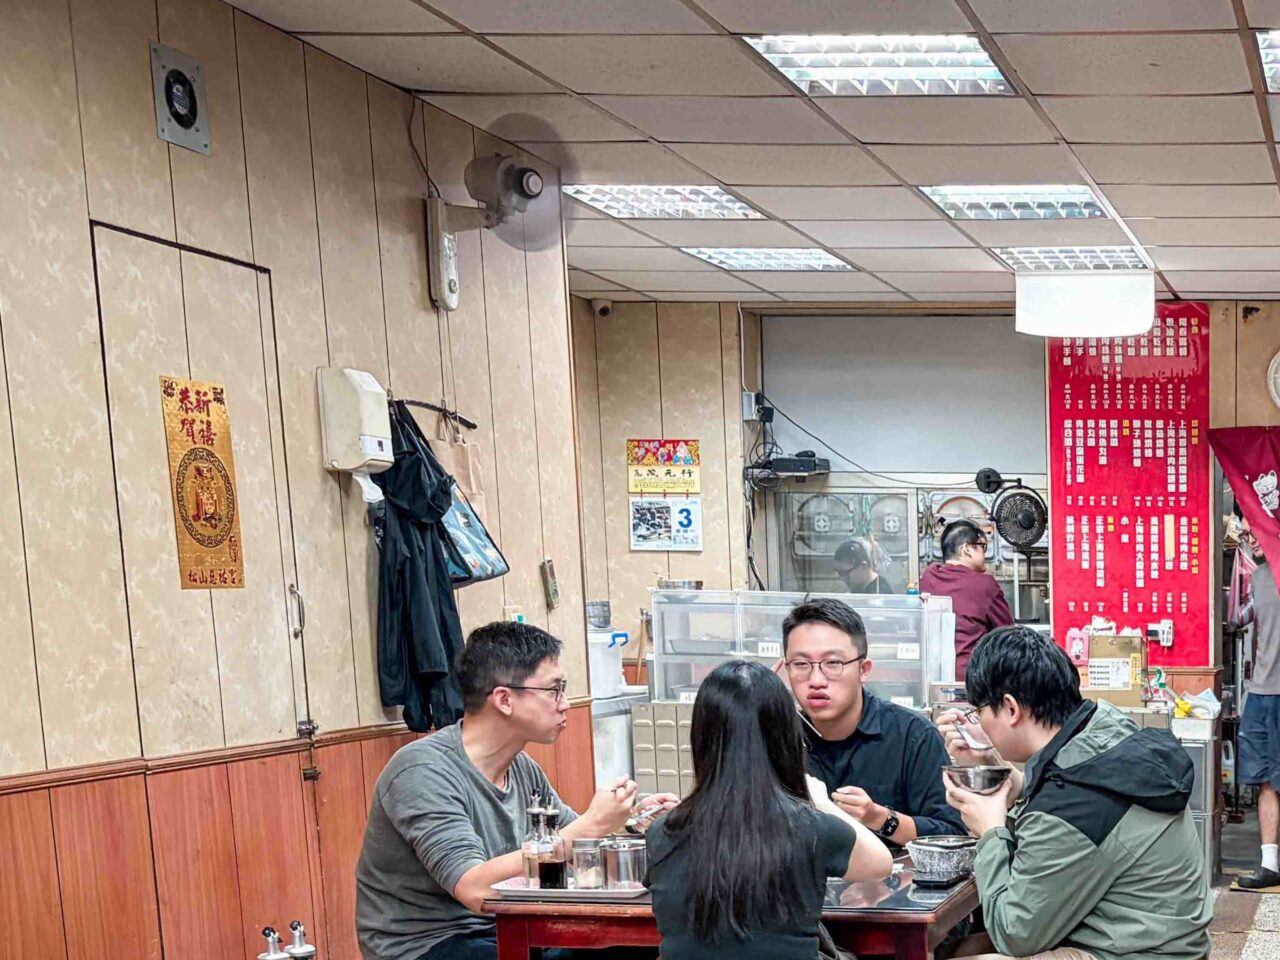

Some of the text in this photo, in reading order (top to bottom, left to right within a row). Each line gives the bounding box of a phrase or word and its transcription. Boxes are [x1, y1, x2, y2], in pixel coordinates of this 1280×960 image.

[178, 386, 197, 445] 恭賀
[194, 390, 217, 446] 新禧
[678, 508, 692, 528] 3
